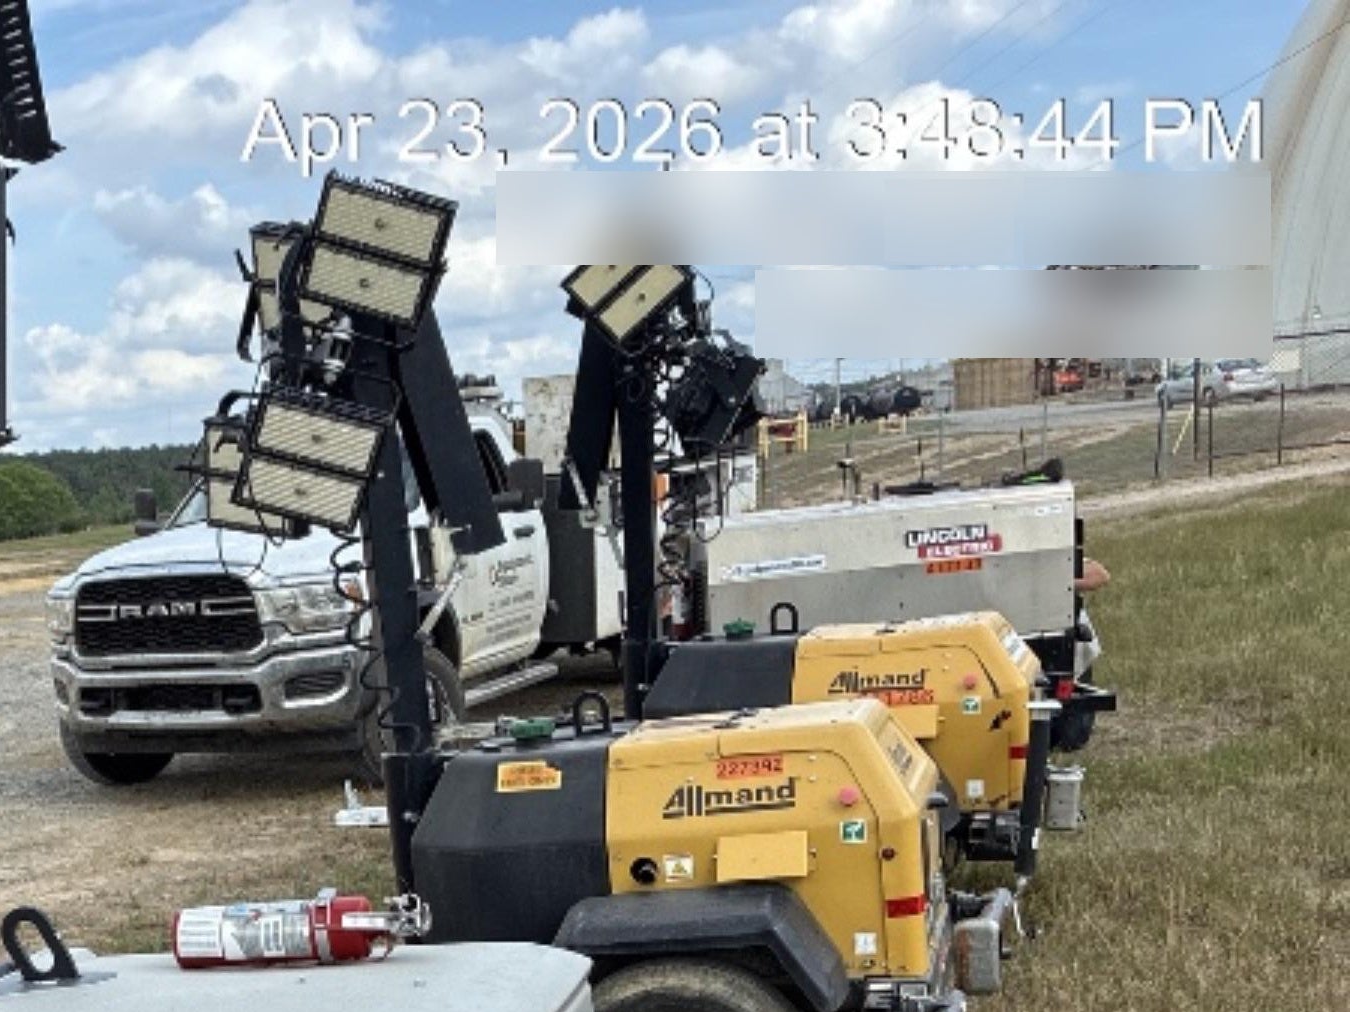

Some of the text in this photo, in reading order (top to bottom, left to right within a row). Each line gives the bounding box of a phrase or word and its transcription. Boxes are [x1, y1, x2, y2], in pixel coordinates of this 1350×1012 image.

[908, 526, 986, 548] LINCOLN
[120, 601, 195, 619] RAM
[828, 668, 925, 693] Allmand
[662, 777, 796, 819] Allmand
